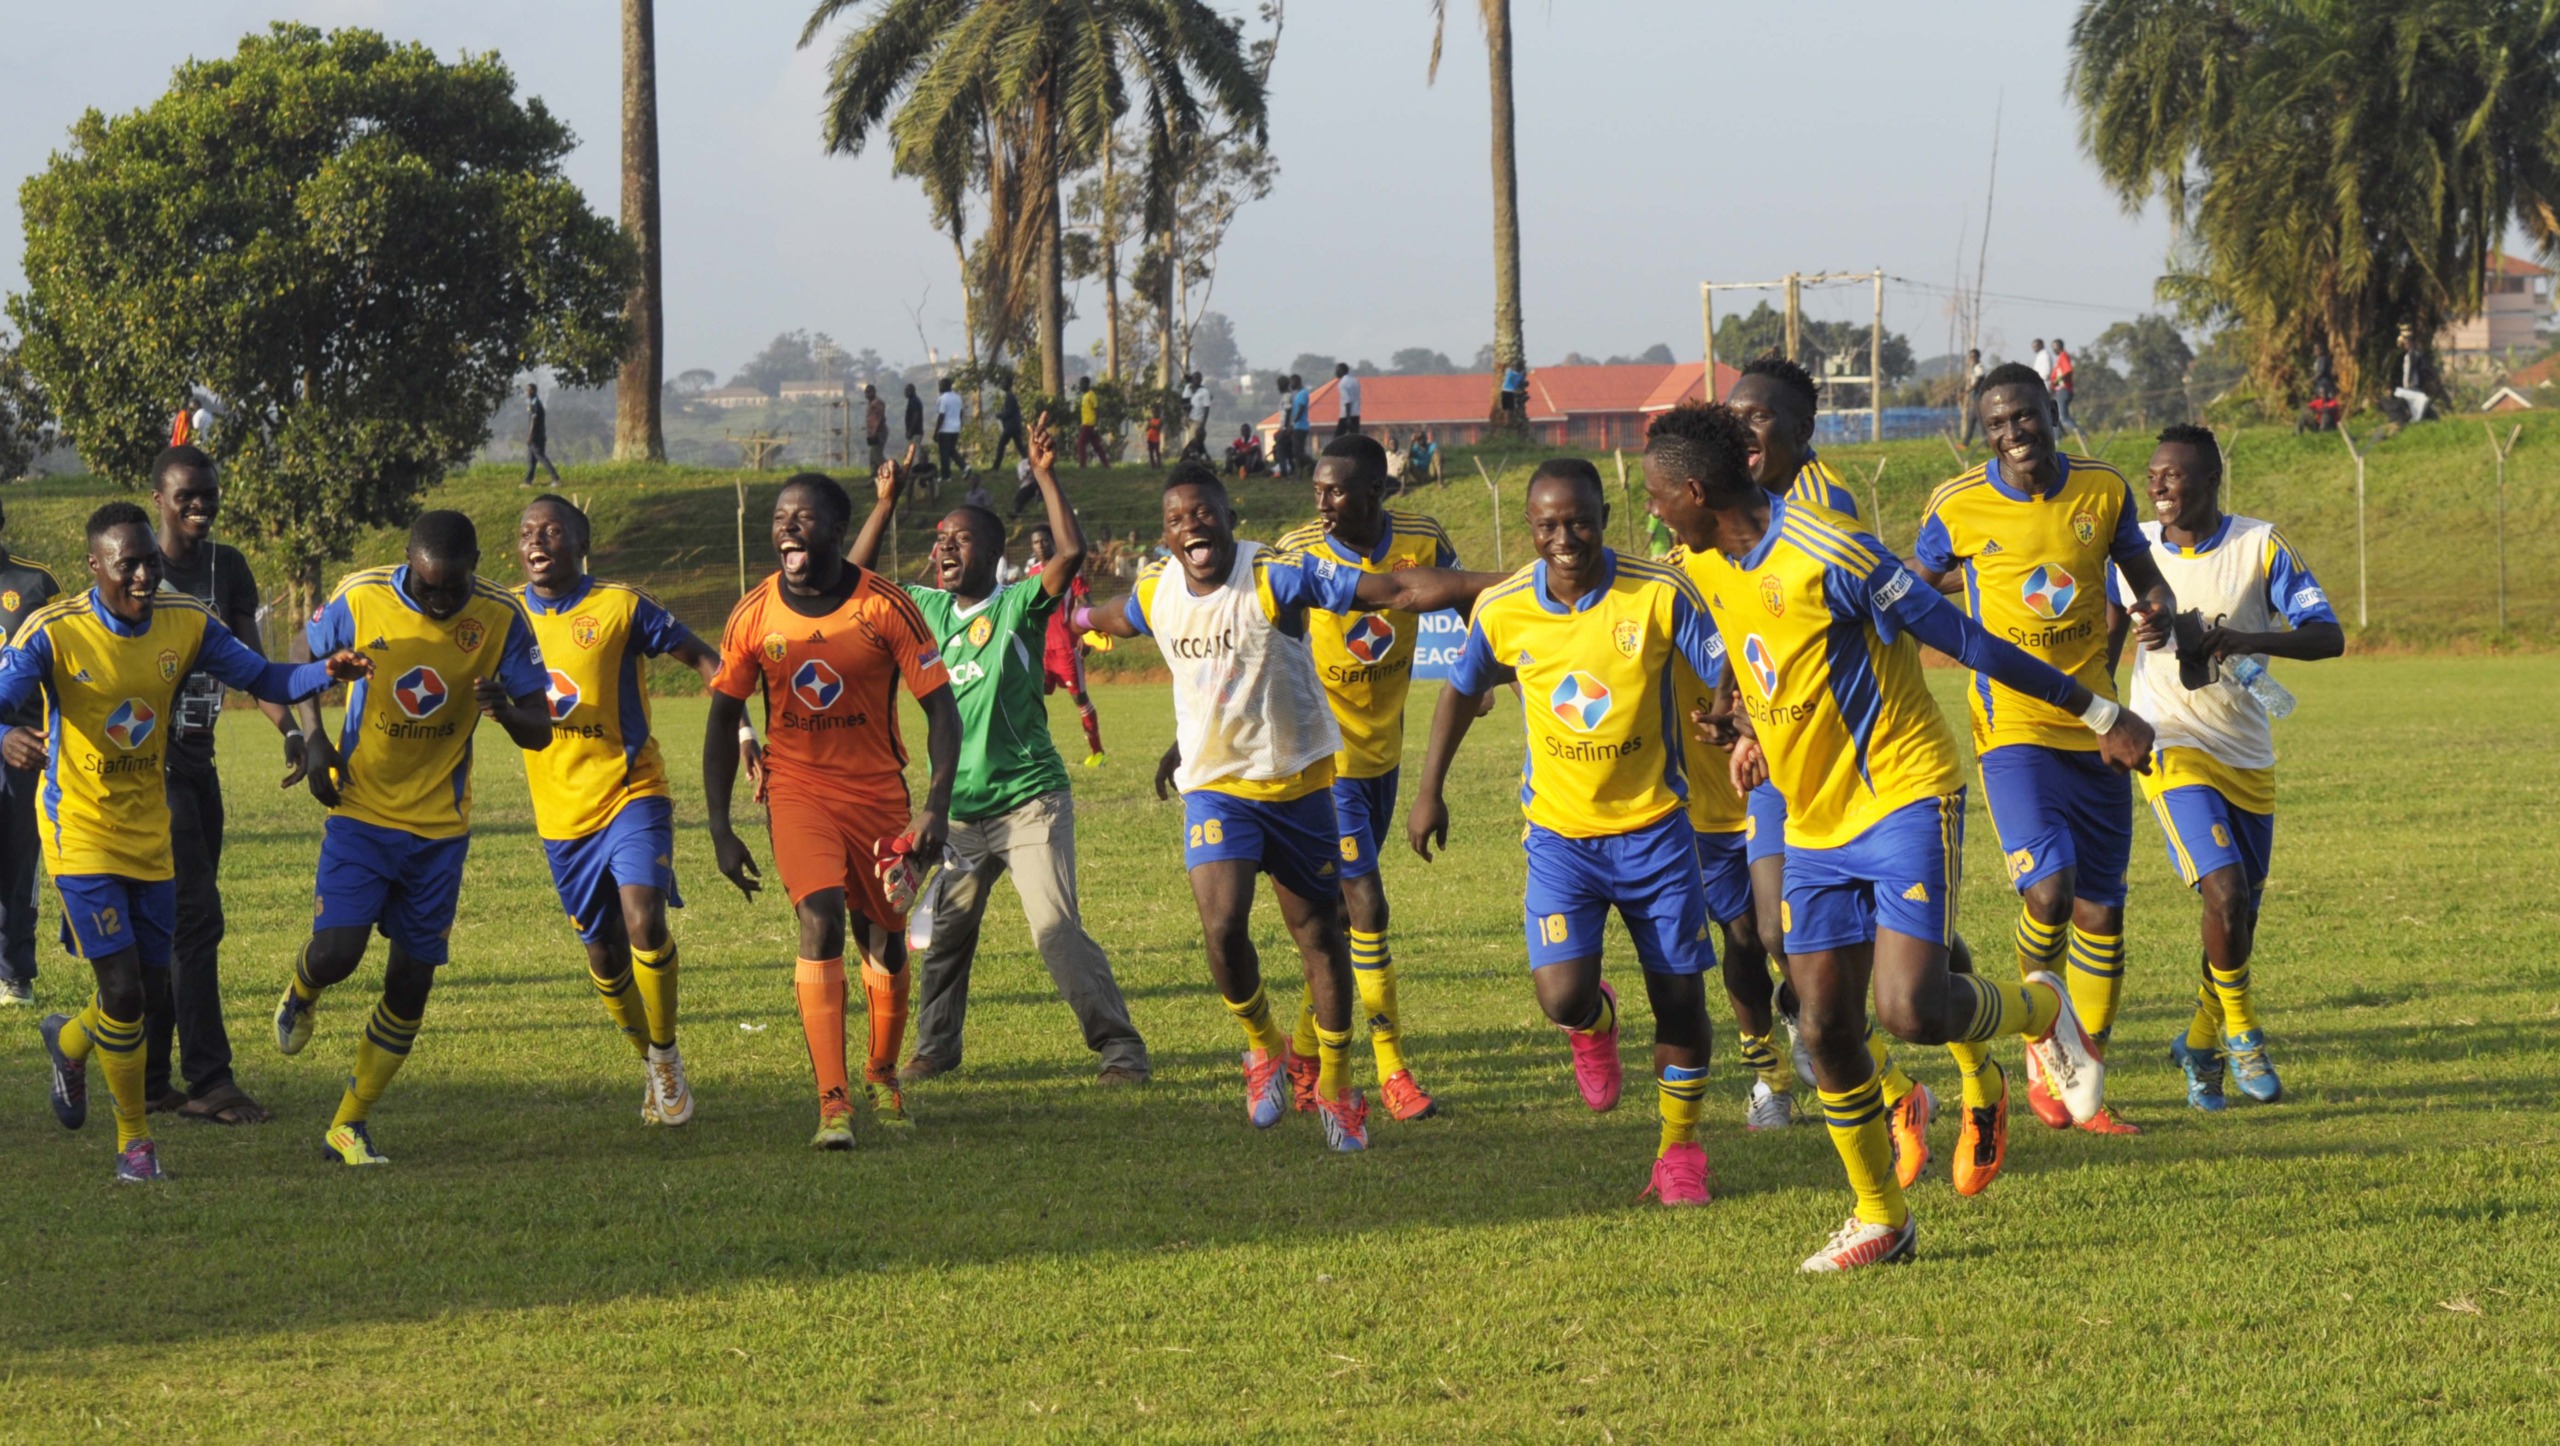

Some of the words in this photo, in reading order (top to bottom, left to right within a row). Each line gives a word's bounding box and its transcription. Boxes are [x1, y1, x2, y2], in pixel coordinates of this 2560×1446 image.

[1874, 571, 1909, 606] Britam
[2008, 621, 2093, 648] StarTimes
[1327, 656, 1408, 685] StarTimes
[374, 711, 456, 740] StarTimes
[782, 711, 867, 733] StarTimes
[1545, 735, 1642, 763] StarTimes
[1189, 818, 1224, 849] 26
[2211, 823, 2231, 848] 8
[1339, 836, 1359, 862] 9
[2008, 848, 2035, 881] 25
[91, 907, 122, 937] 12
[1538, 912, 1568, 947] 18
